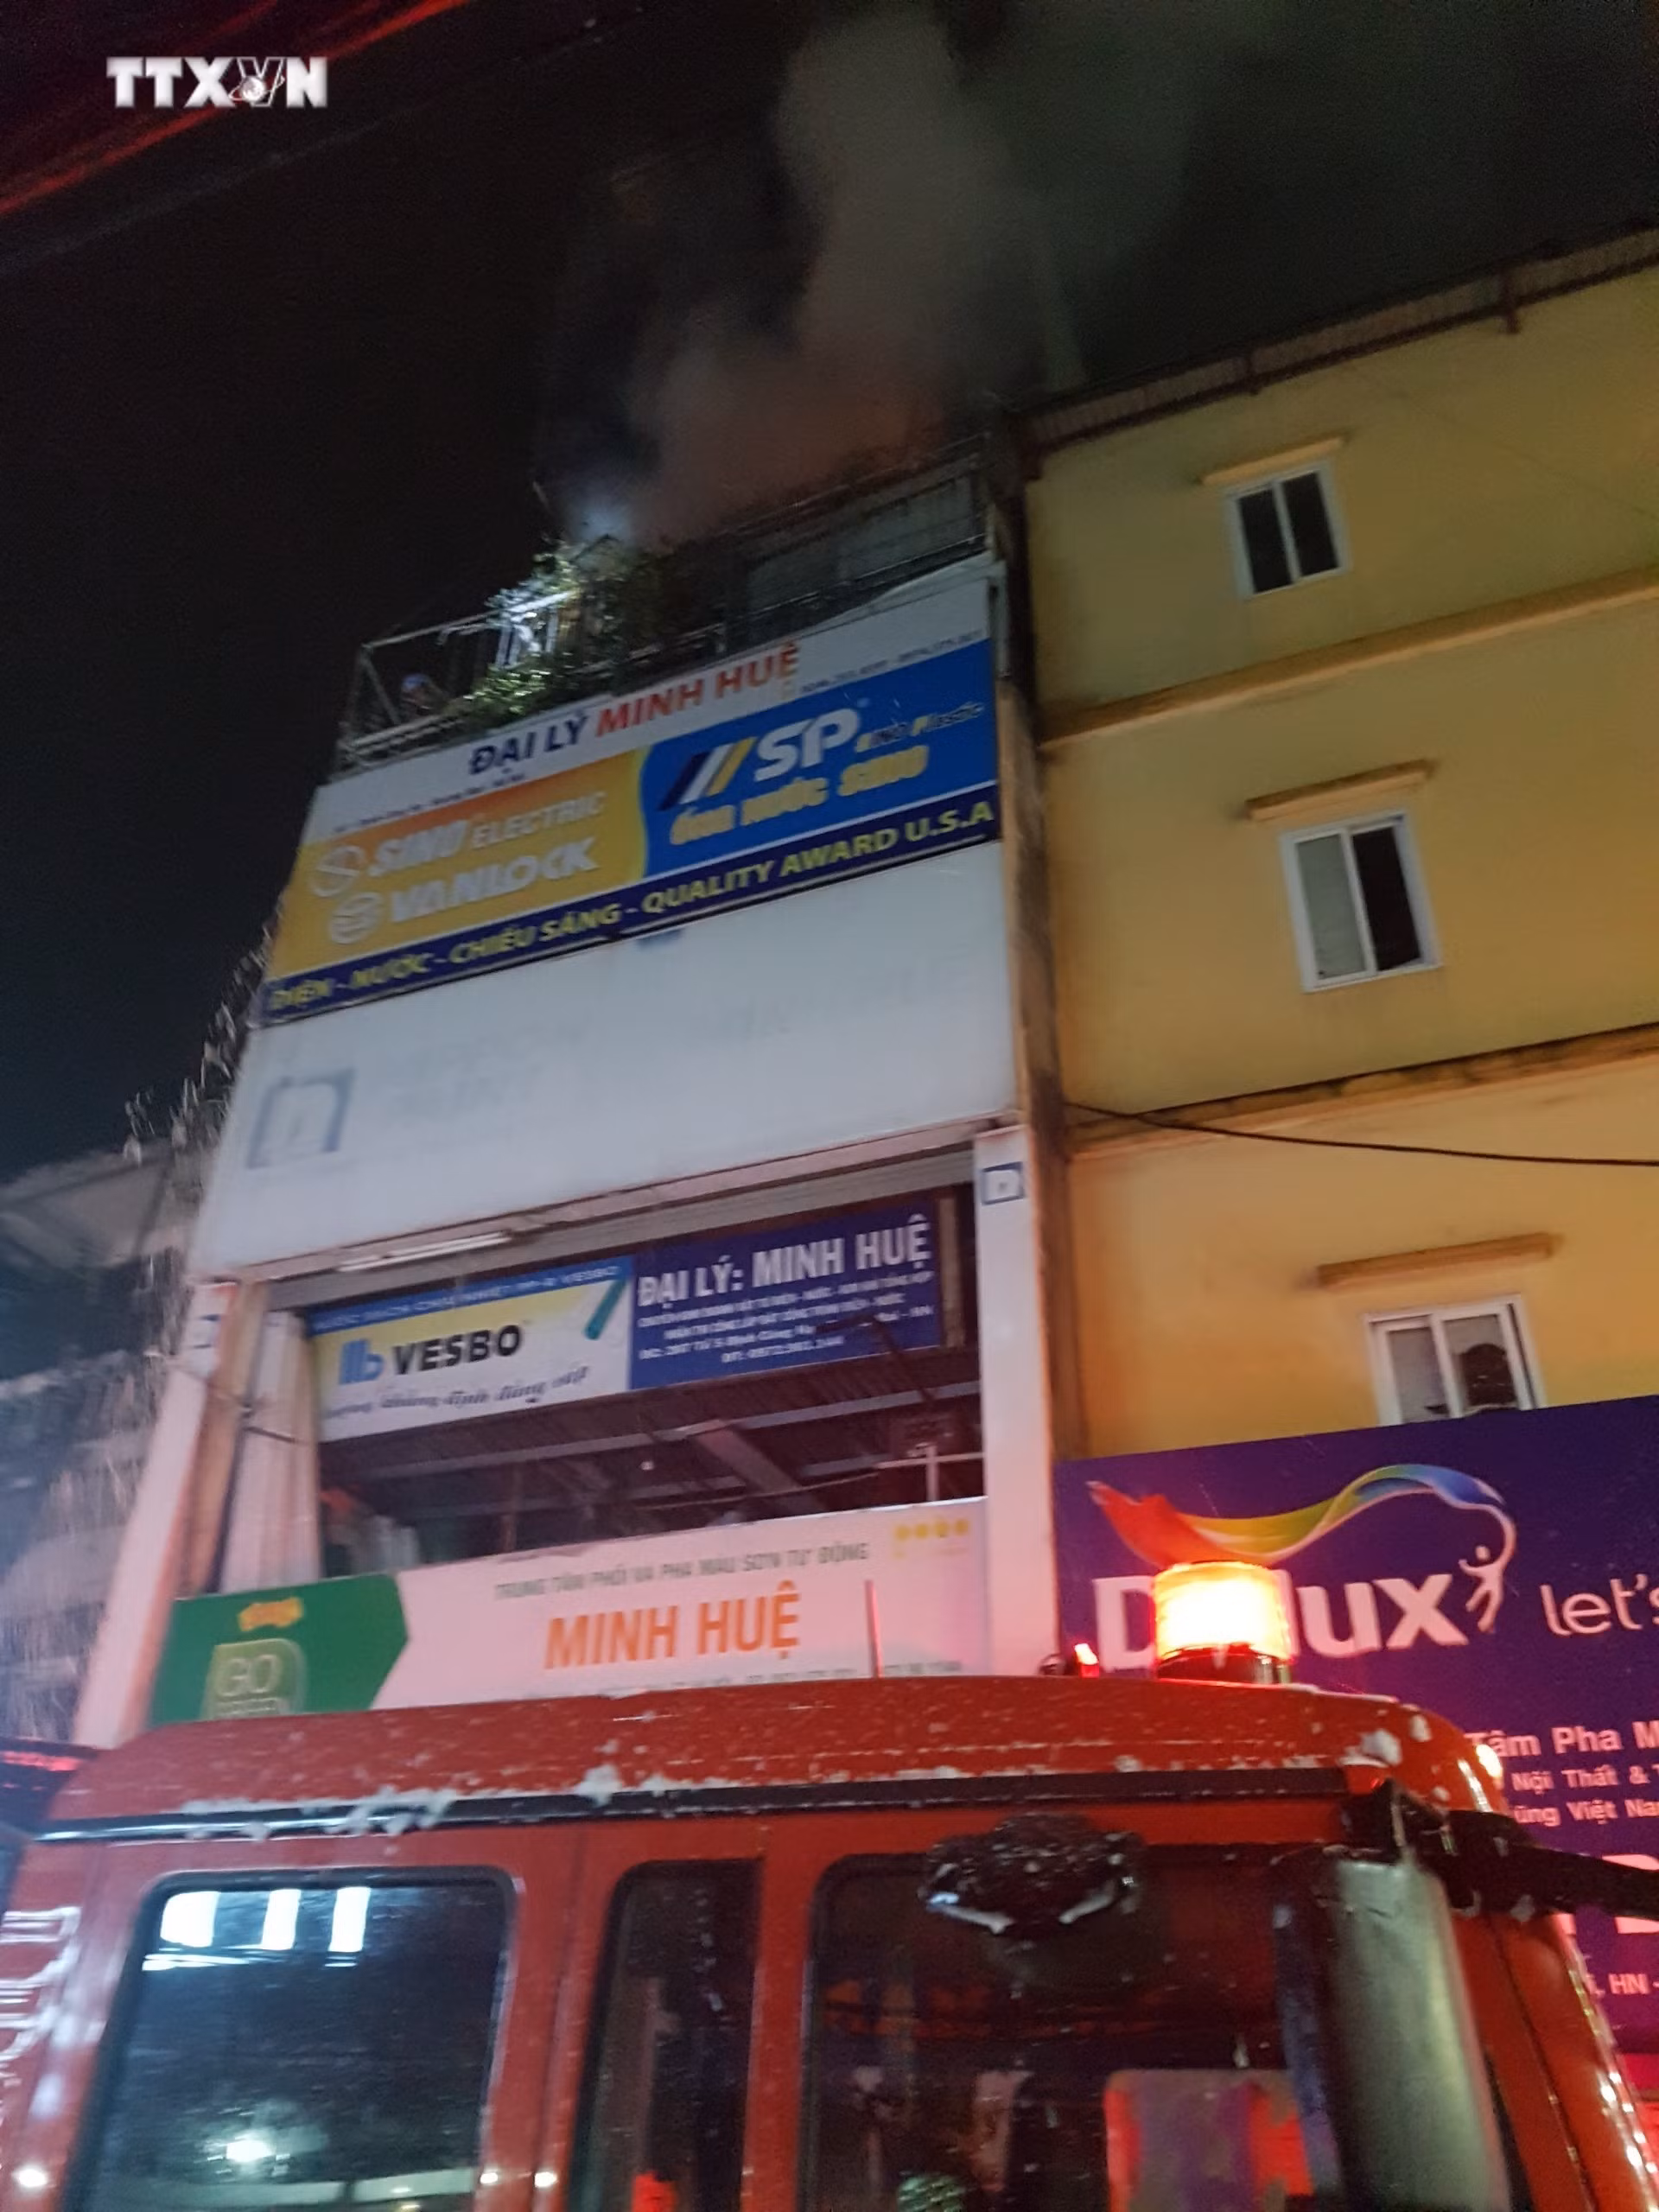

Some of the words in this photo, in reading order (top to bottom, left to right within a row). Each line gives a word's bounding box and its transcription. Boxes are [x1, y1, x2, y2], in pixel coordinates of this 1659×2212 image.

[468, 730, 534, 773] ĐẠI
[595, 679, 704, 737] MINH
[753, 708, 861, 781] SP
[471, 791, 606, 849] ELECTRIC
[539, 904, 622, 942] SÁNG
[642, 860, 775, 913] QUALITY
[780, 827, 898, 877] AWARD
[638, 1270, 690, 1309] ĐẠI
[753, 1237, 844, 1287] MINH
[855, 1213, 931, 1270] HUỆ
[393, 1325, 522, 1375] VESBO
[543, 1605, 678, 1669] MINH
[696, 1580, 799, 1660] HUỆ
[1552, 1726, 1624, 1754] Pha
[1512, 1771, 1554, 1795] Nội
[1630, 1765, 1650, 1784] &
[1566, 1800, 1618, 1825] Việt
[1608, 1974, 1649, 1995] HN
